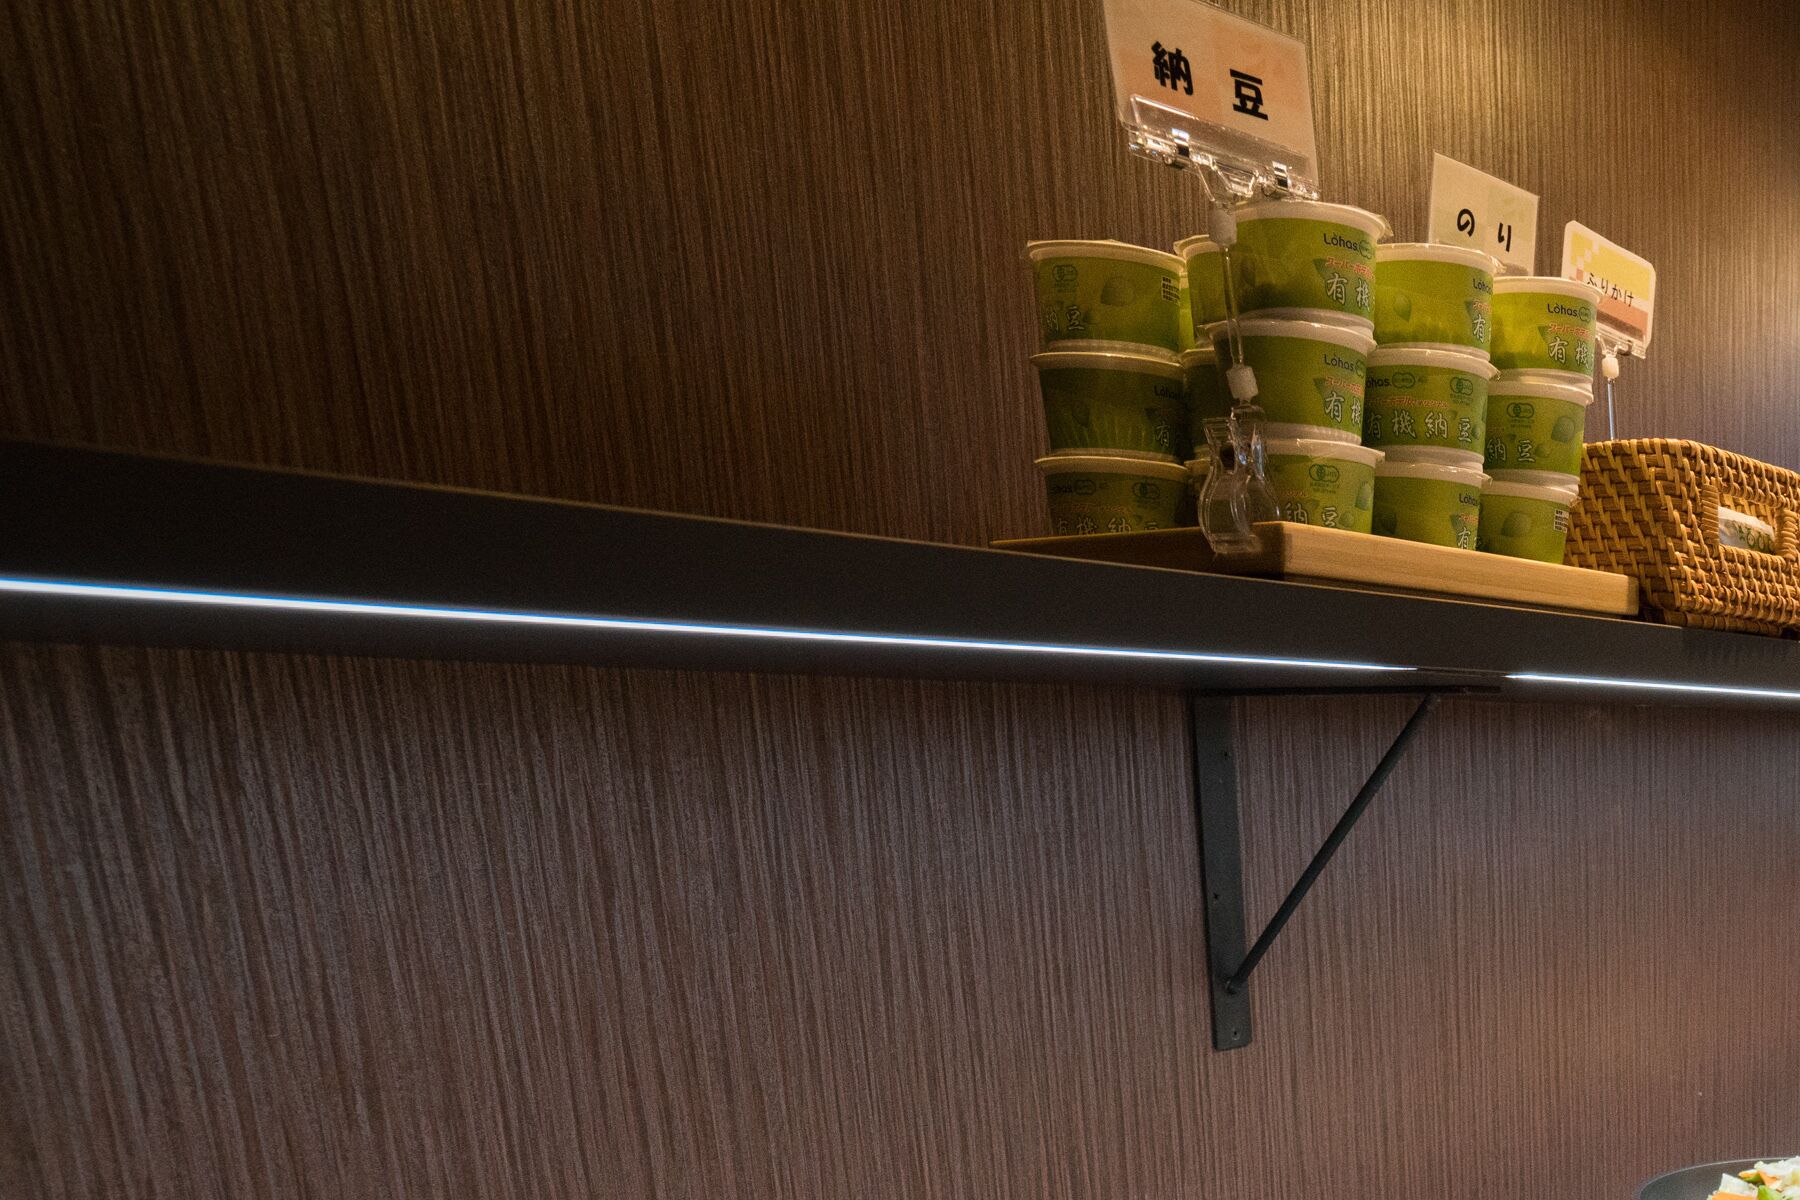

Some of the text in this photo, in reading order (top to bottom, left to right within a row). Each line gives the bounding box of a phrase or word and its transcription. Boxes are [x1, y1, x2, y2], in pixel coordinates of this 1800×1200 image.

[1150, 41, 1269, 122] 納豆
[1456, 207, 1512, 253] のり
[1586, 272, 1635, 308] ふりかけ
[1367, 408, 1473, 443] 有機納豆
[1486, 438, 1537, 463] 納豆
